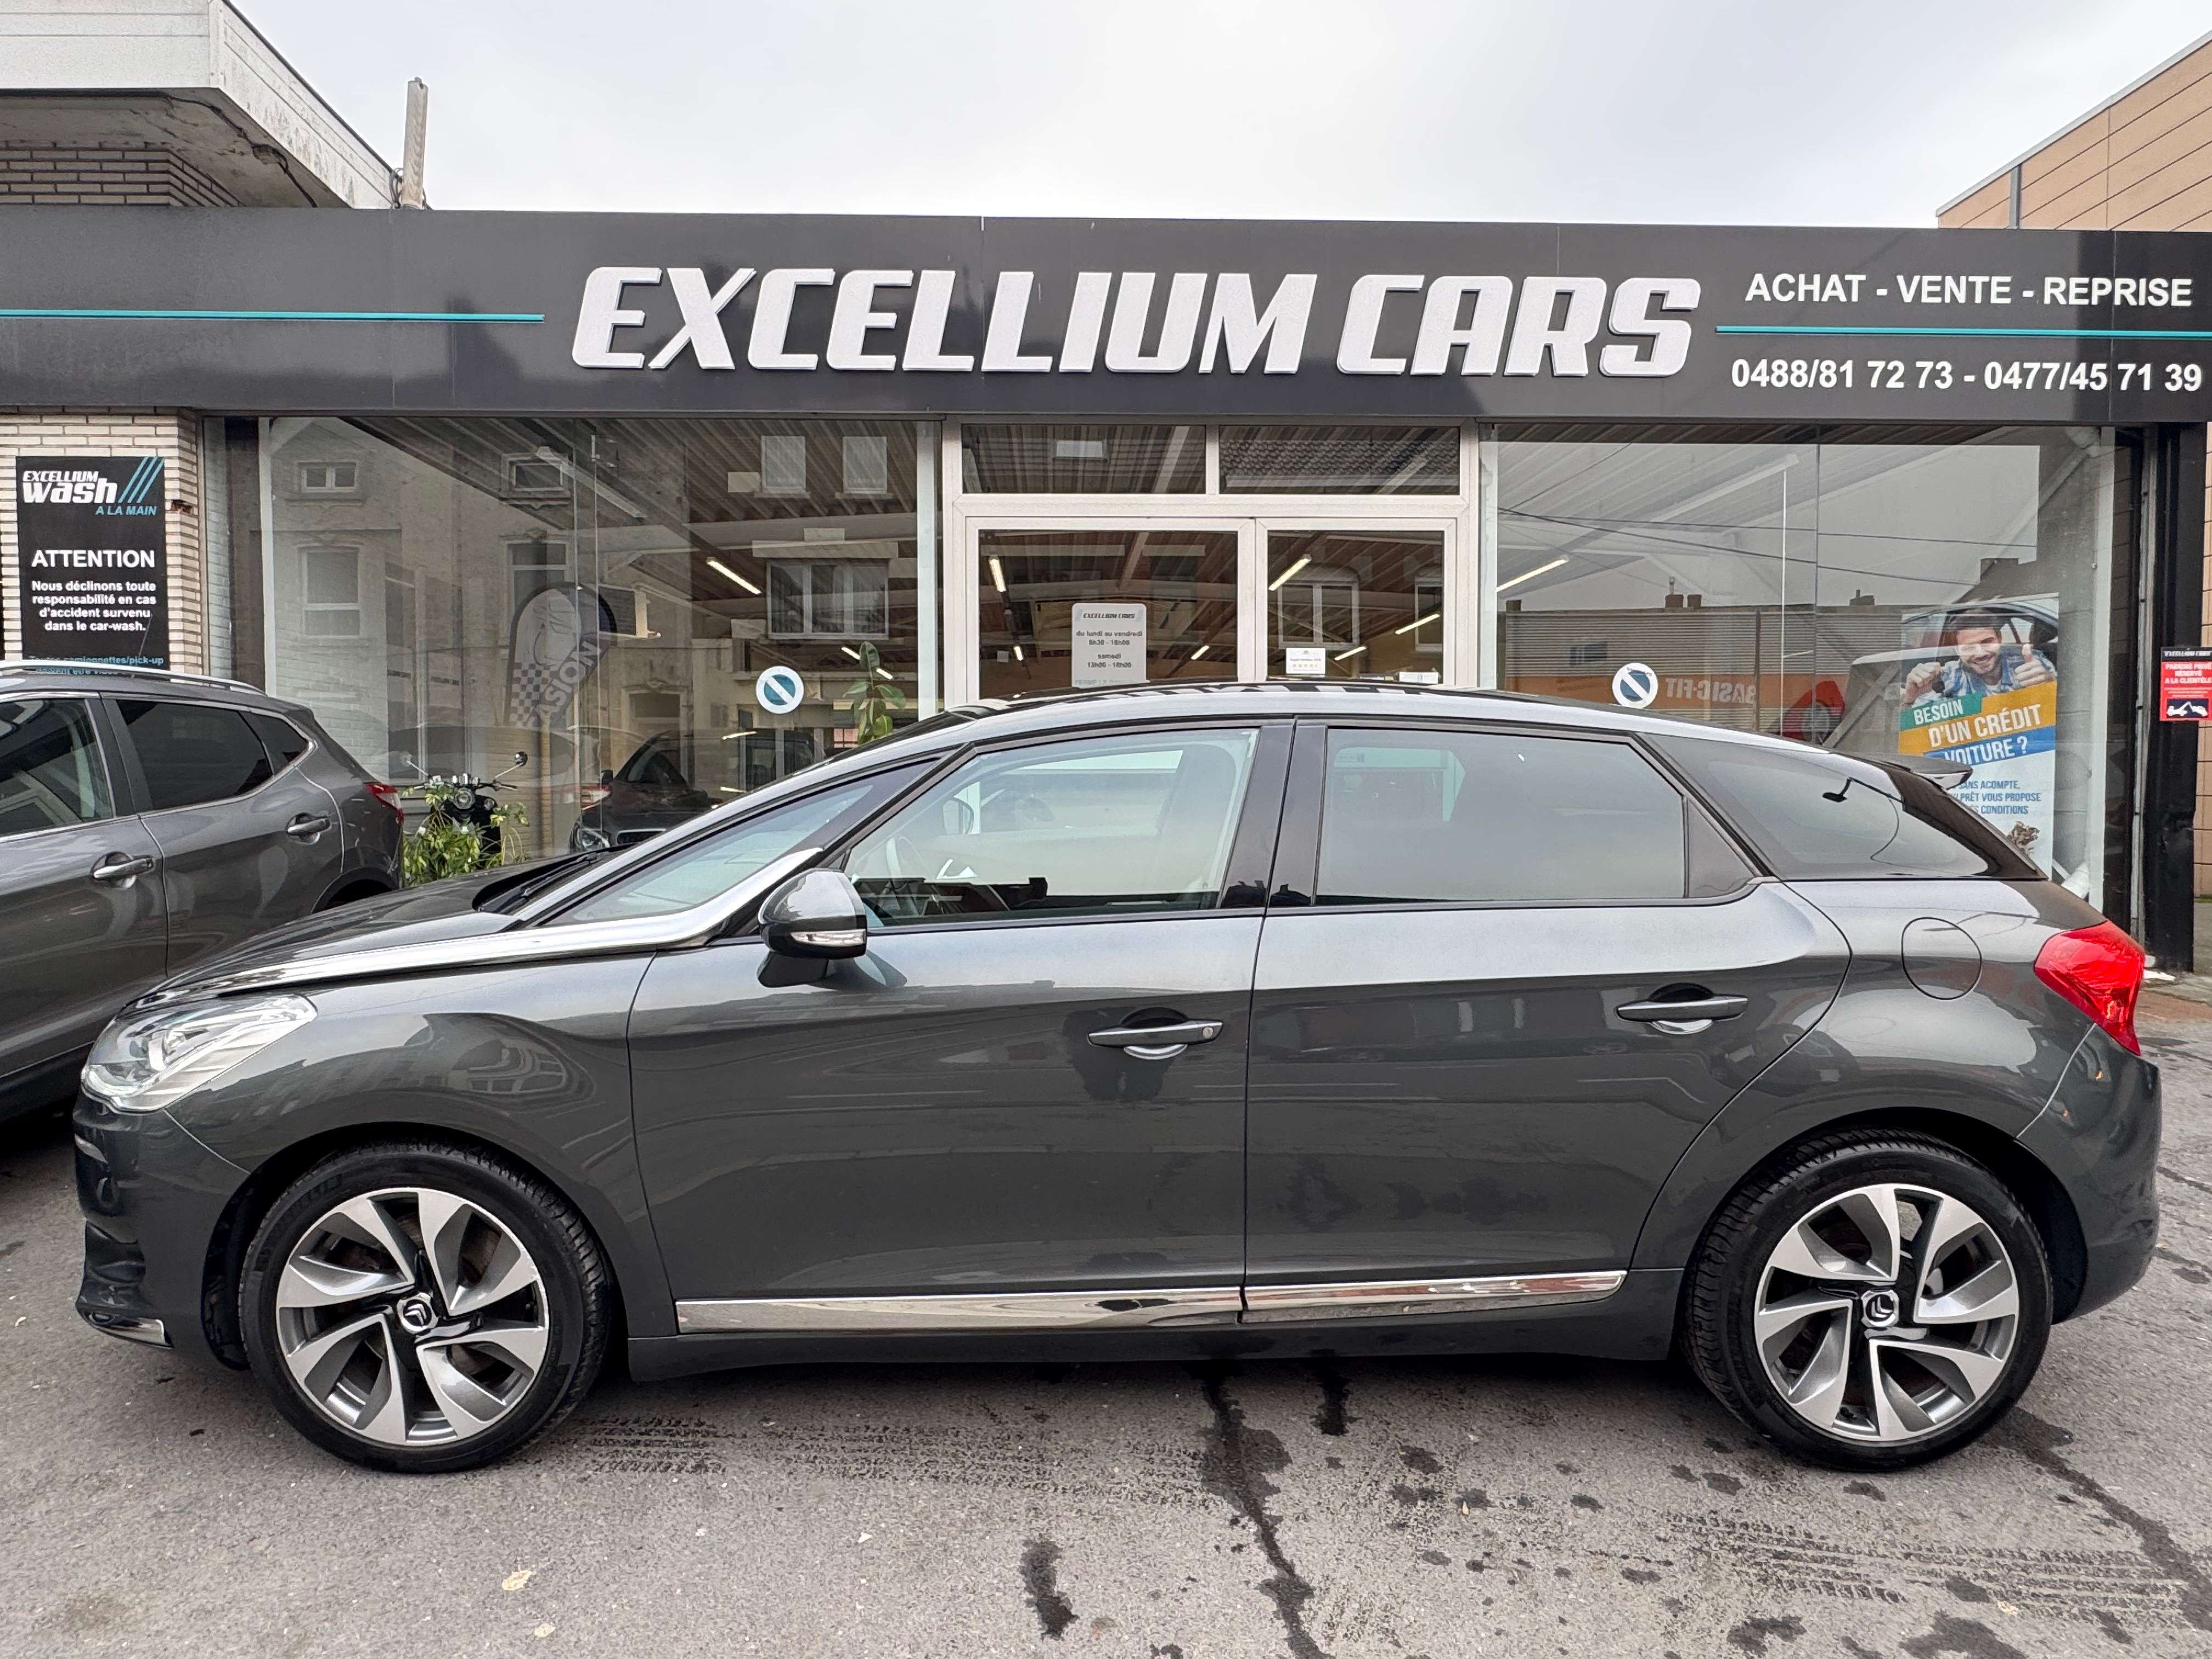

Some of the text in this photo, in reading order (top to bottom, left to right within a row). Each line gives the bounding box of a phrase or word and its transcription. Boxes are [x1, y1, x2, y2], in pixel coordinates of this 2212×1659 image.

[1745, 273, 1866, 302] ACHAT
[1897, 275, 2012, 304] VENTE
[2044, 277, 2192, 307] REPRISE
[572, 267, 1701, 377] EXCELLIUM CARS
[1731, 359, 1854, 389] 0488/81
[1867, 360, 1905, 390] 72
[1916, 361, 1953, 390] 73
[1984, 361, 2107, 391] 0477/45
[2118, 363, 2155, 392] 71
[2165, 363, 2202, 392] 39
[22, 471, 99, 482] EXCELLIUM
[22, 478, 117, 504] wash
[95, 506, 157, 516] A LA MAIN
[31, 550, 155, 567] ATTENTION
[31, 580, 156, 591] Nous déclinons toute
[32, 594, 157, 606] responsabilité en cas
[39, 607, 151, 618] d'accident survenu
[44, 620, 147, 631] dans le car-wash.
[1914, 699, 1963, 725] BESOIN
[1928, 704, 2041, 748] D'UN CRÉDIT
[2017, 736, 2028, 754] ?
[1982, 793, 2002, 802] VOUS
[2005, 793, 2041, 802] PROPOSE
[1980, 806, 2029, 814] CONDITIONS
